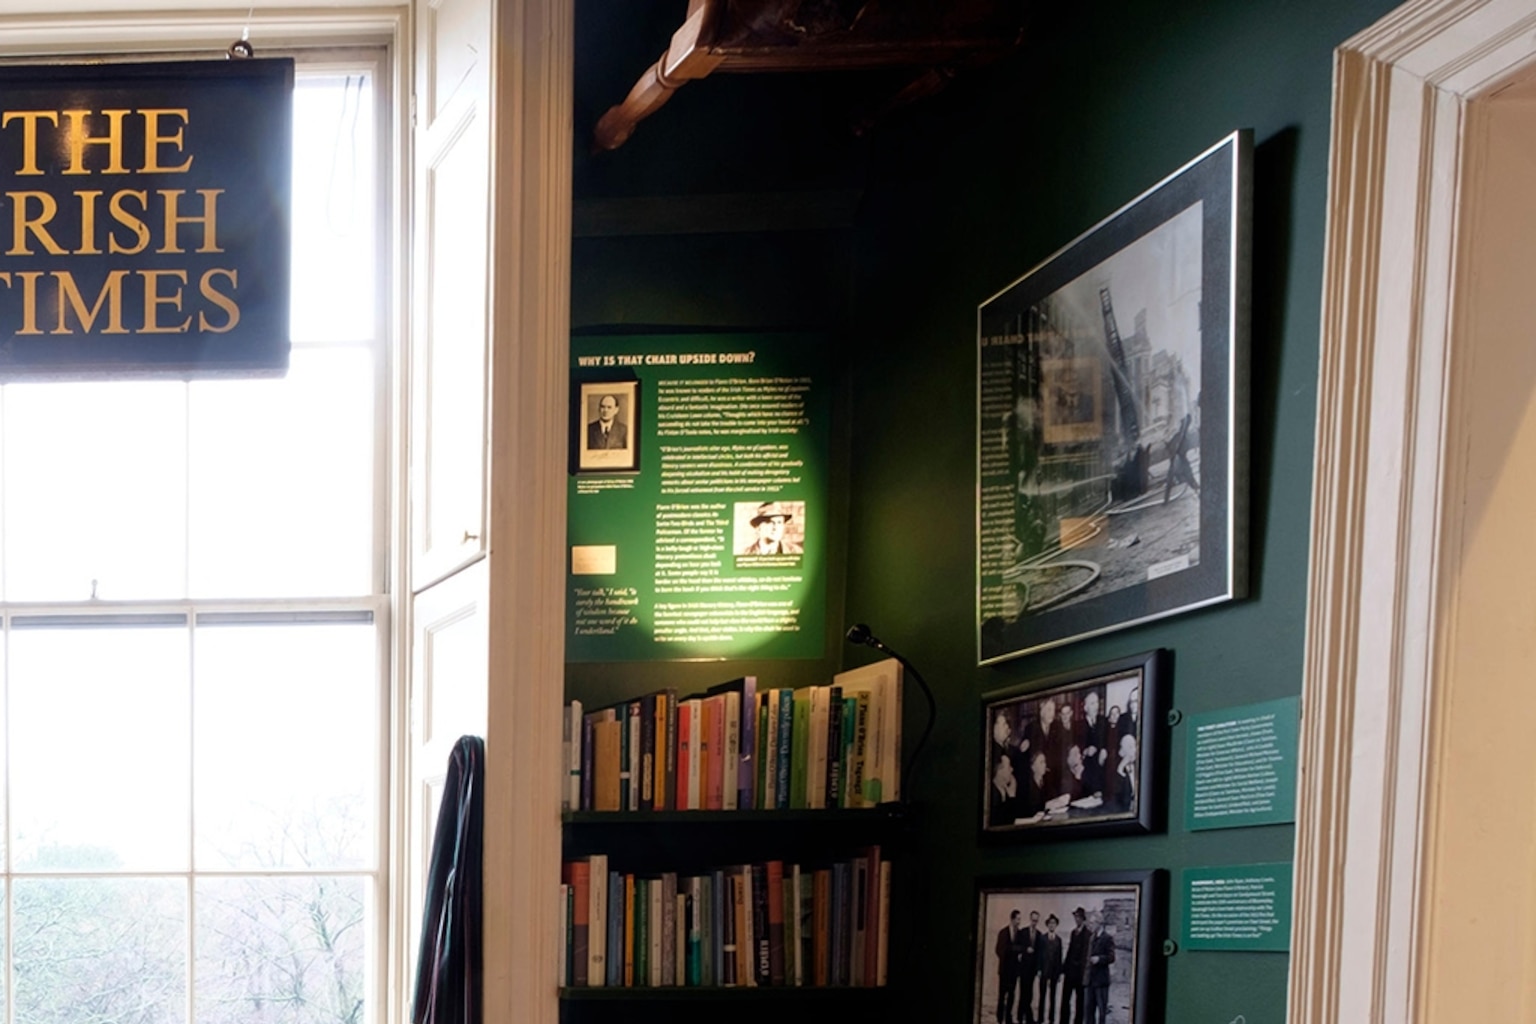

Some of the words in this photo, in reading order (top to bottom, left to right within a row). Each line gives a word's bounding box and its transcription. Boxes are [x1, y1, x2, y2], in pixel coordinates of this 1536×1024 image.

[2, 108, 194, 175] THE
[578, 356, 601, 367] WHY
[604, 356, 615, 366] IS
[618, 355, 643, 366] THAT
[645, 354, 678, 365] CHAIR
[679, 353, 717, 364] UPSIDE
[719, 351, 755, 363] DOWN?
[858, 703, 867, 726] Flann
[857, 727, 866, 756] O'Brien
